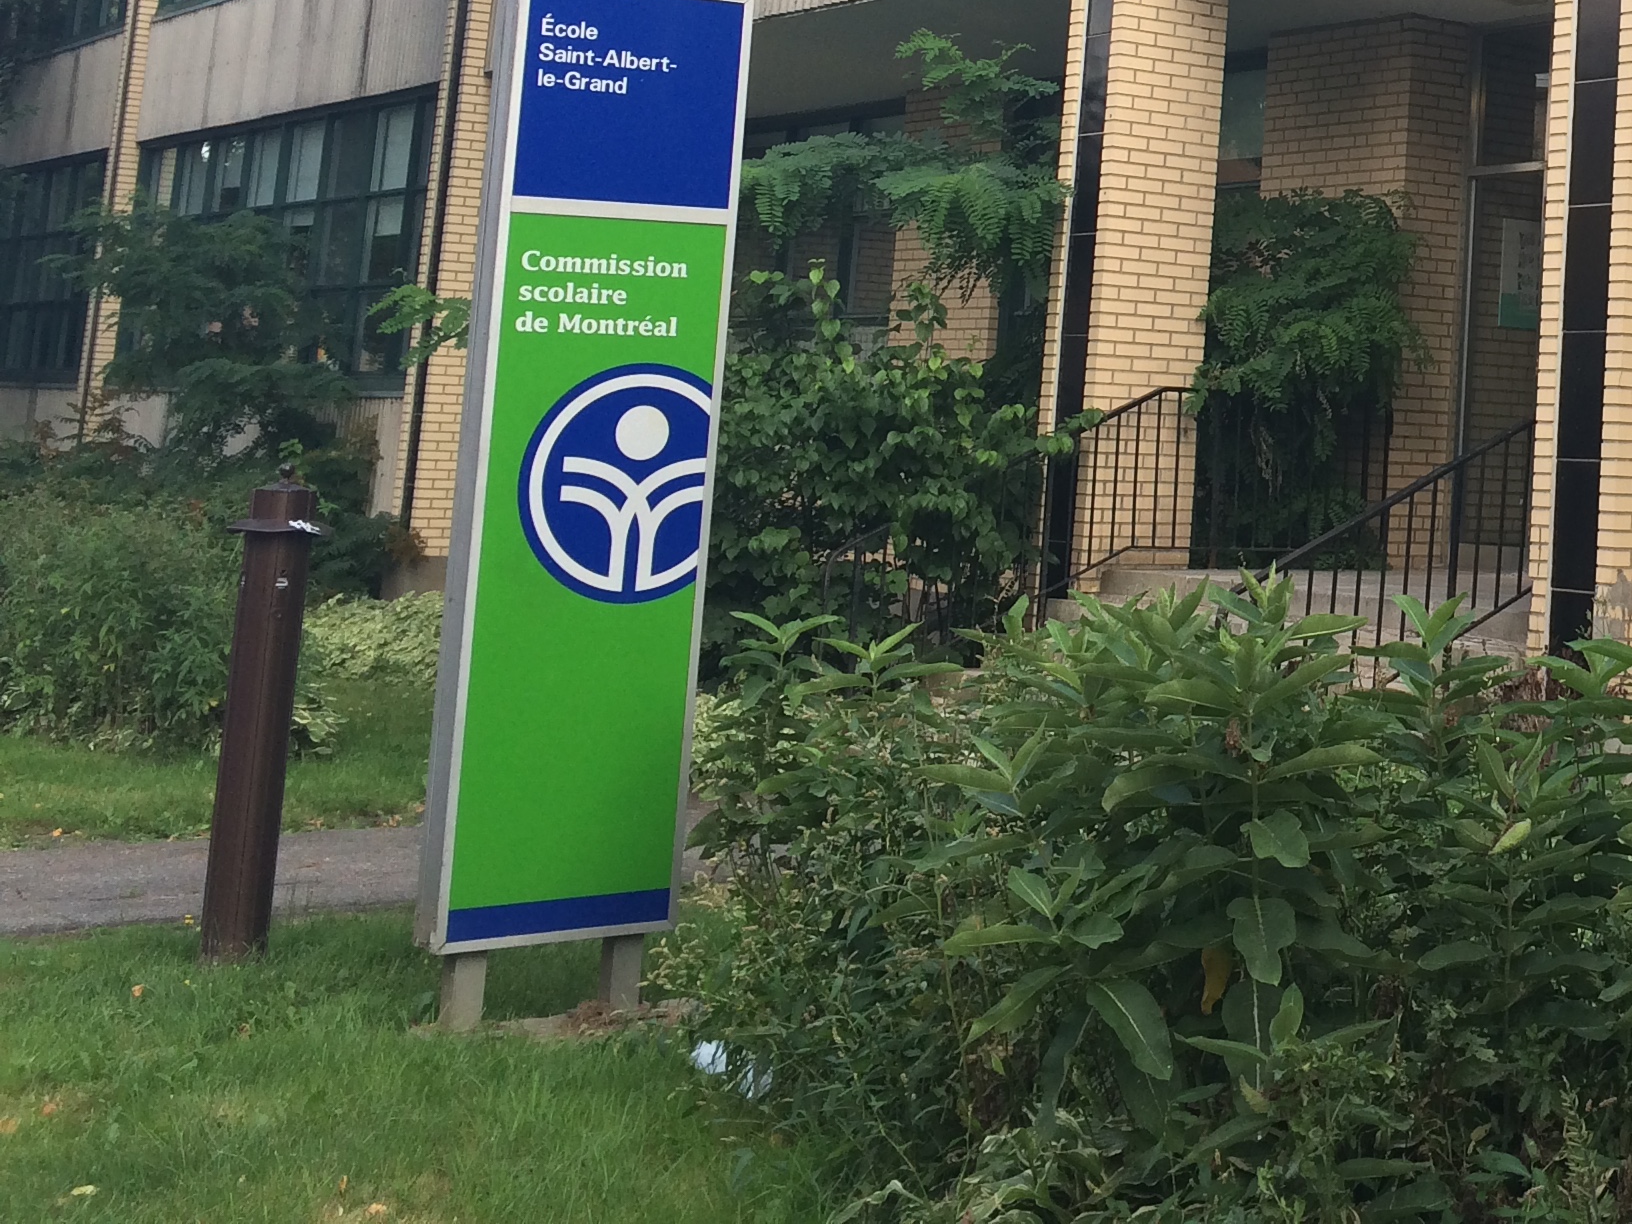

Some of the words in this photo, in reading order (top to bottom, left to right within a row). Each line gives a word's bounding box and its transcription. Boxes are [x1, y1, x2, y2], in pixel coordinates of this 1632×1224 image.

[541, 13, 598, 40] École
[538, 43, 677, 73] Saint-Albert-
[537, 69, 628, 94] le-Grand
[521, 250, 688, 278] Commission
[518, 282, 627, 305] scolaire
[515, 311, 549, 333] de
[557, 313, 678, 338] Montréal
